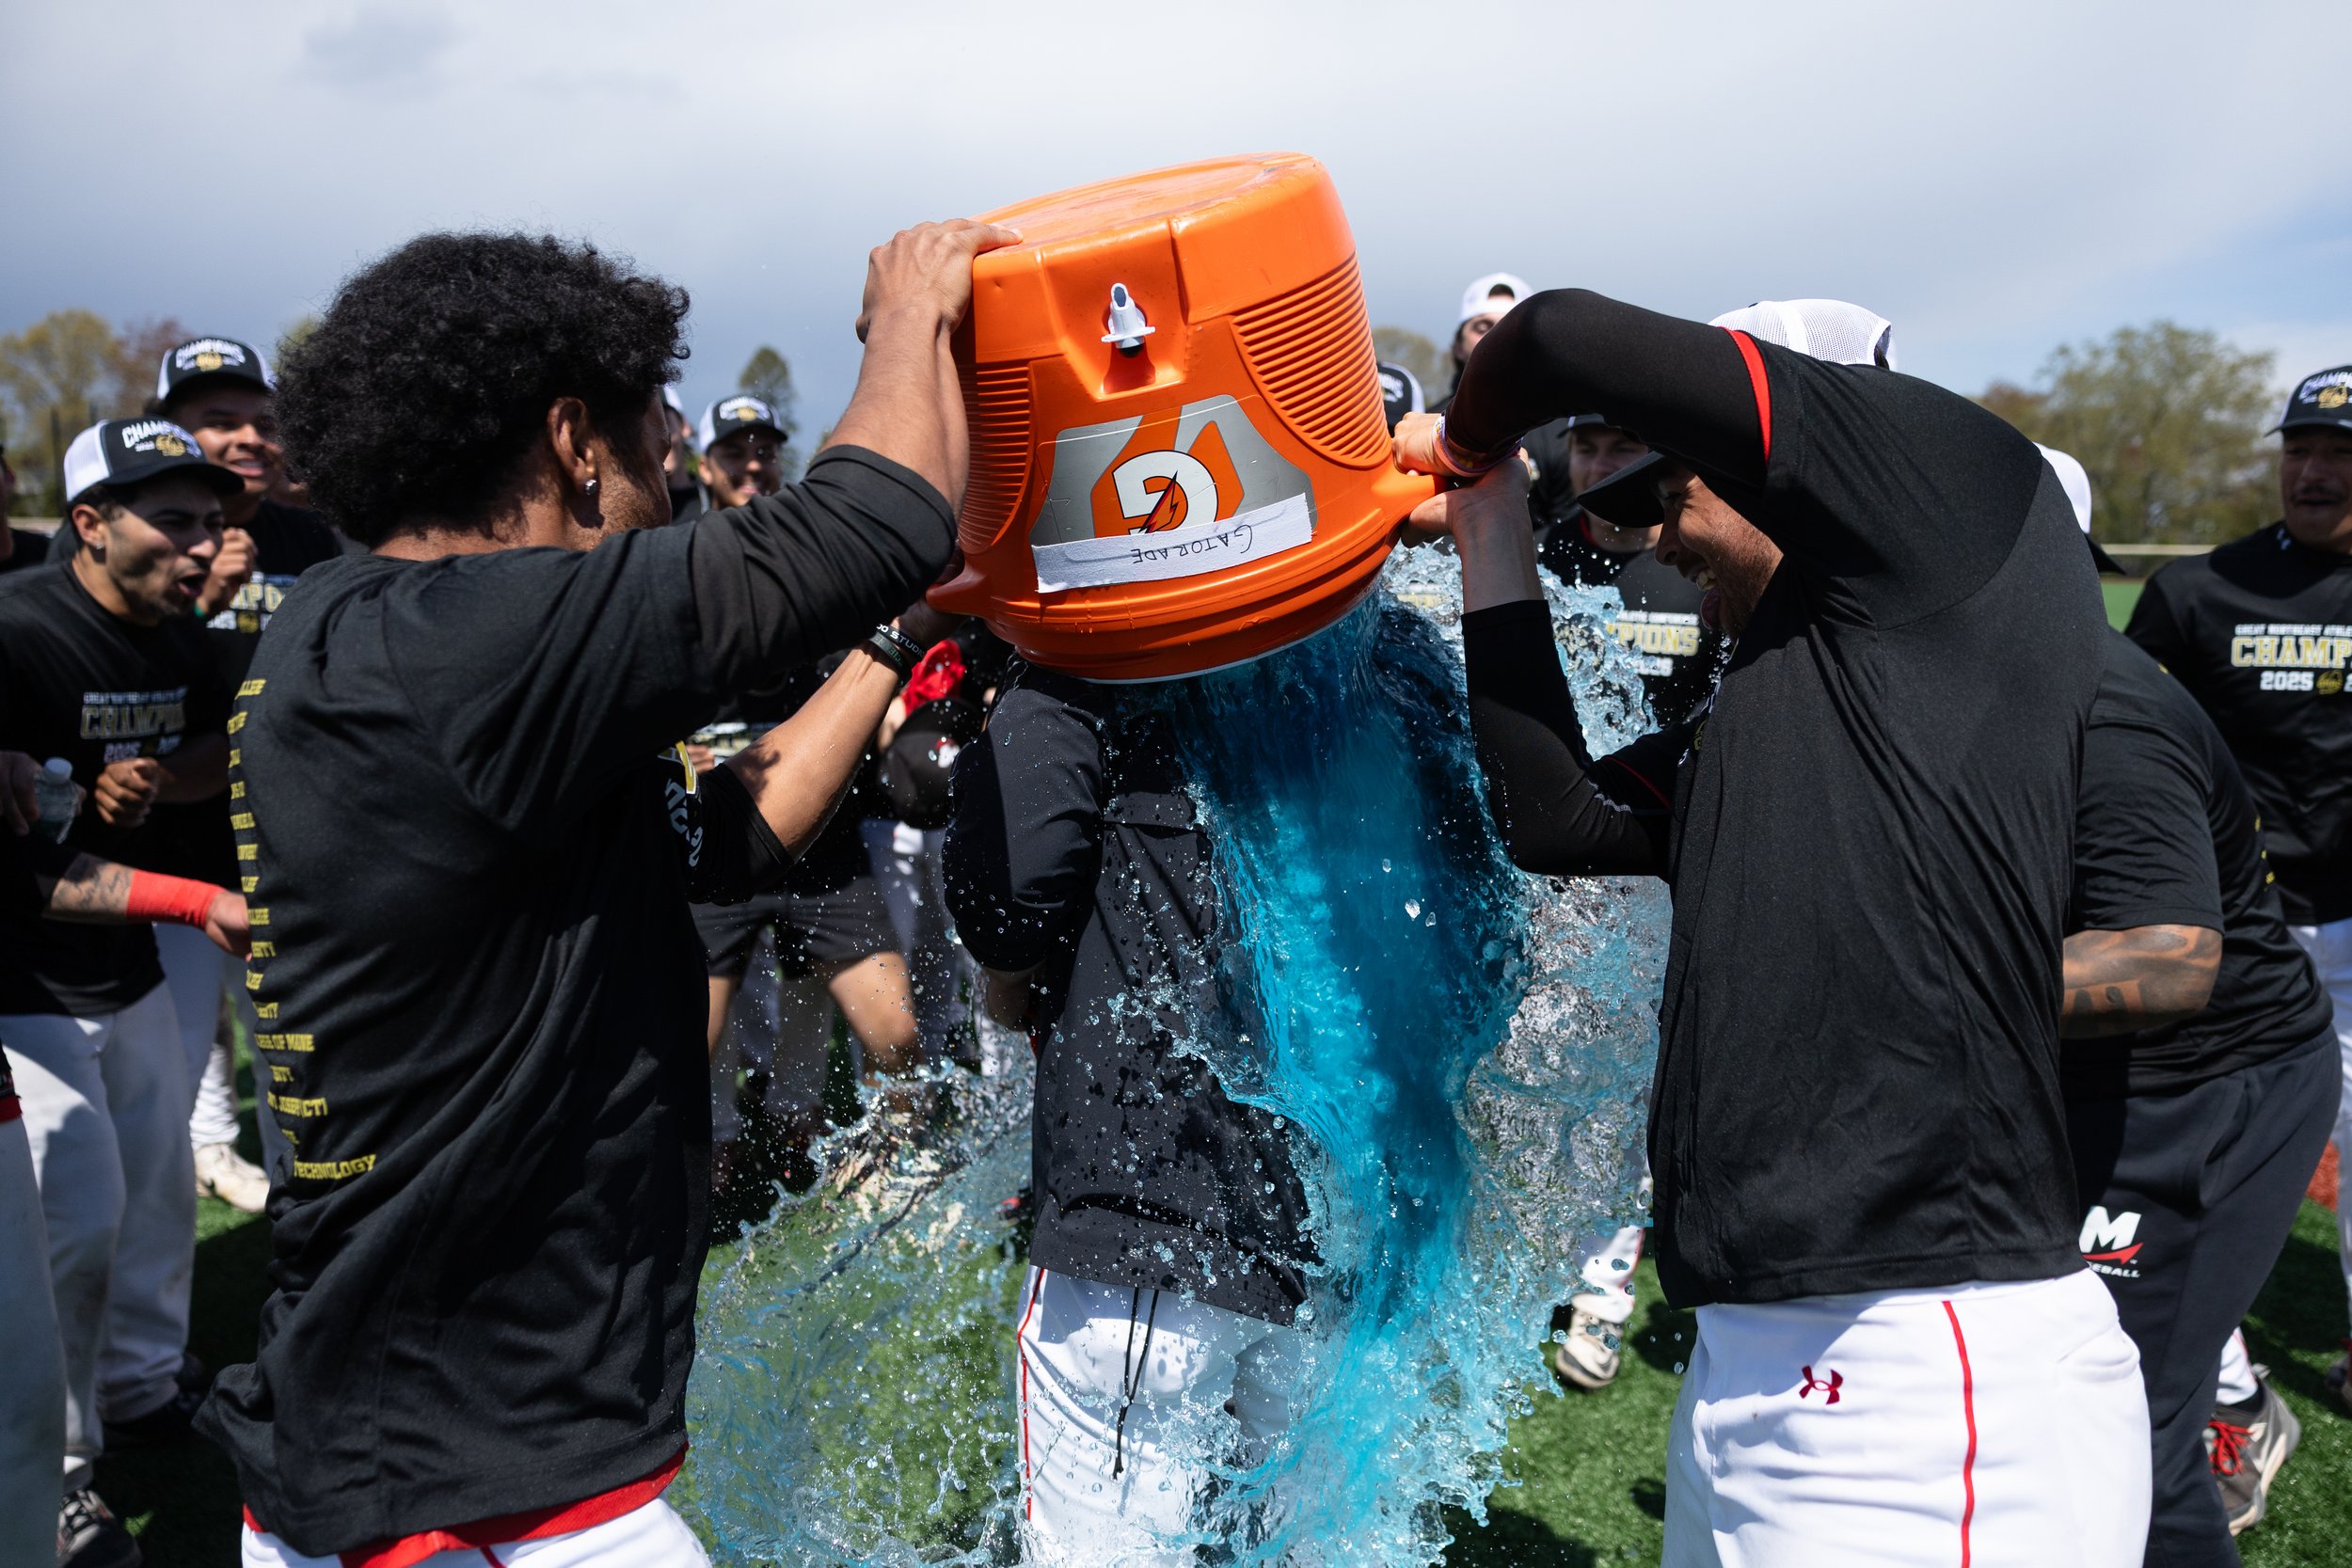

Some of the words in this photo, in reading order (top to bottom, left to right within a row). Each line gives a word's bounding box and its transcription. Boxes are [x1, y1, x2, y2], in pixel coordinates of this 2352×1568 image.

[1131, 524, 1253, 563] GATORADE
[2260, 671, 2314, 691] 2025
[2078, 1205, 2142, 1254] M
